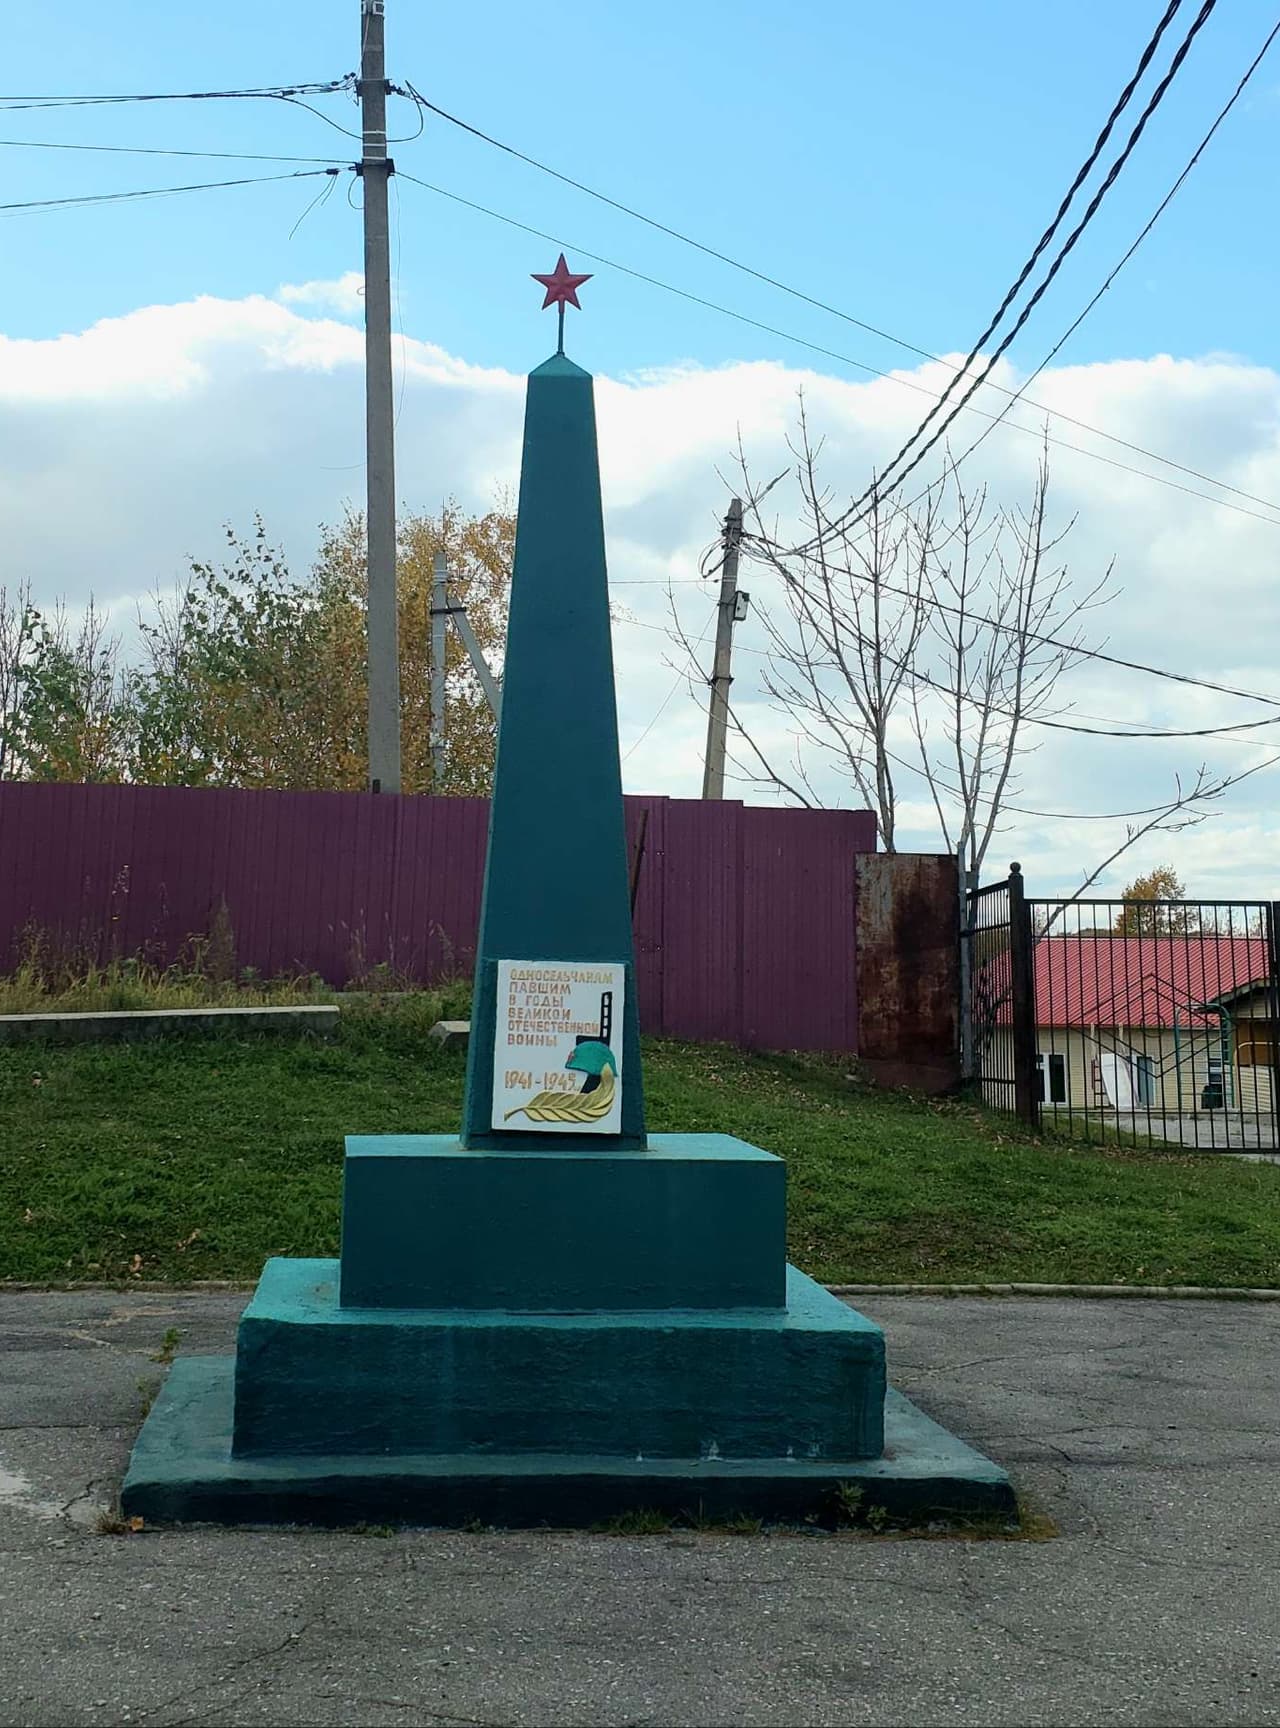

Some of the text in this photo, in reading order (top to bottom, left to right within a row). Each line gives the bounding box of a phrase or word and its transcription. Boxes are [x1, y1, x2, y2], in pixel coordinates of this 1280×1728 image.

[509, 981, 571, 995] ПАВШИМ
[508, 994, 564, 1008] В ГОДЫ
